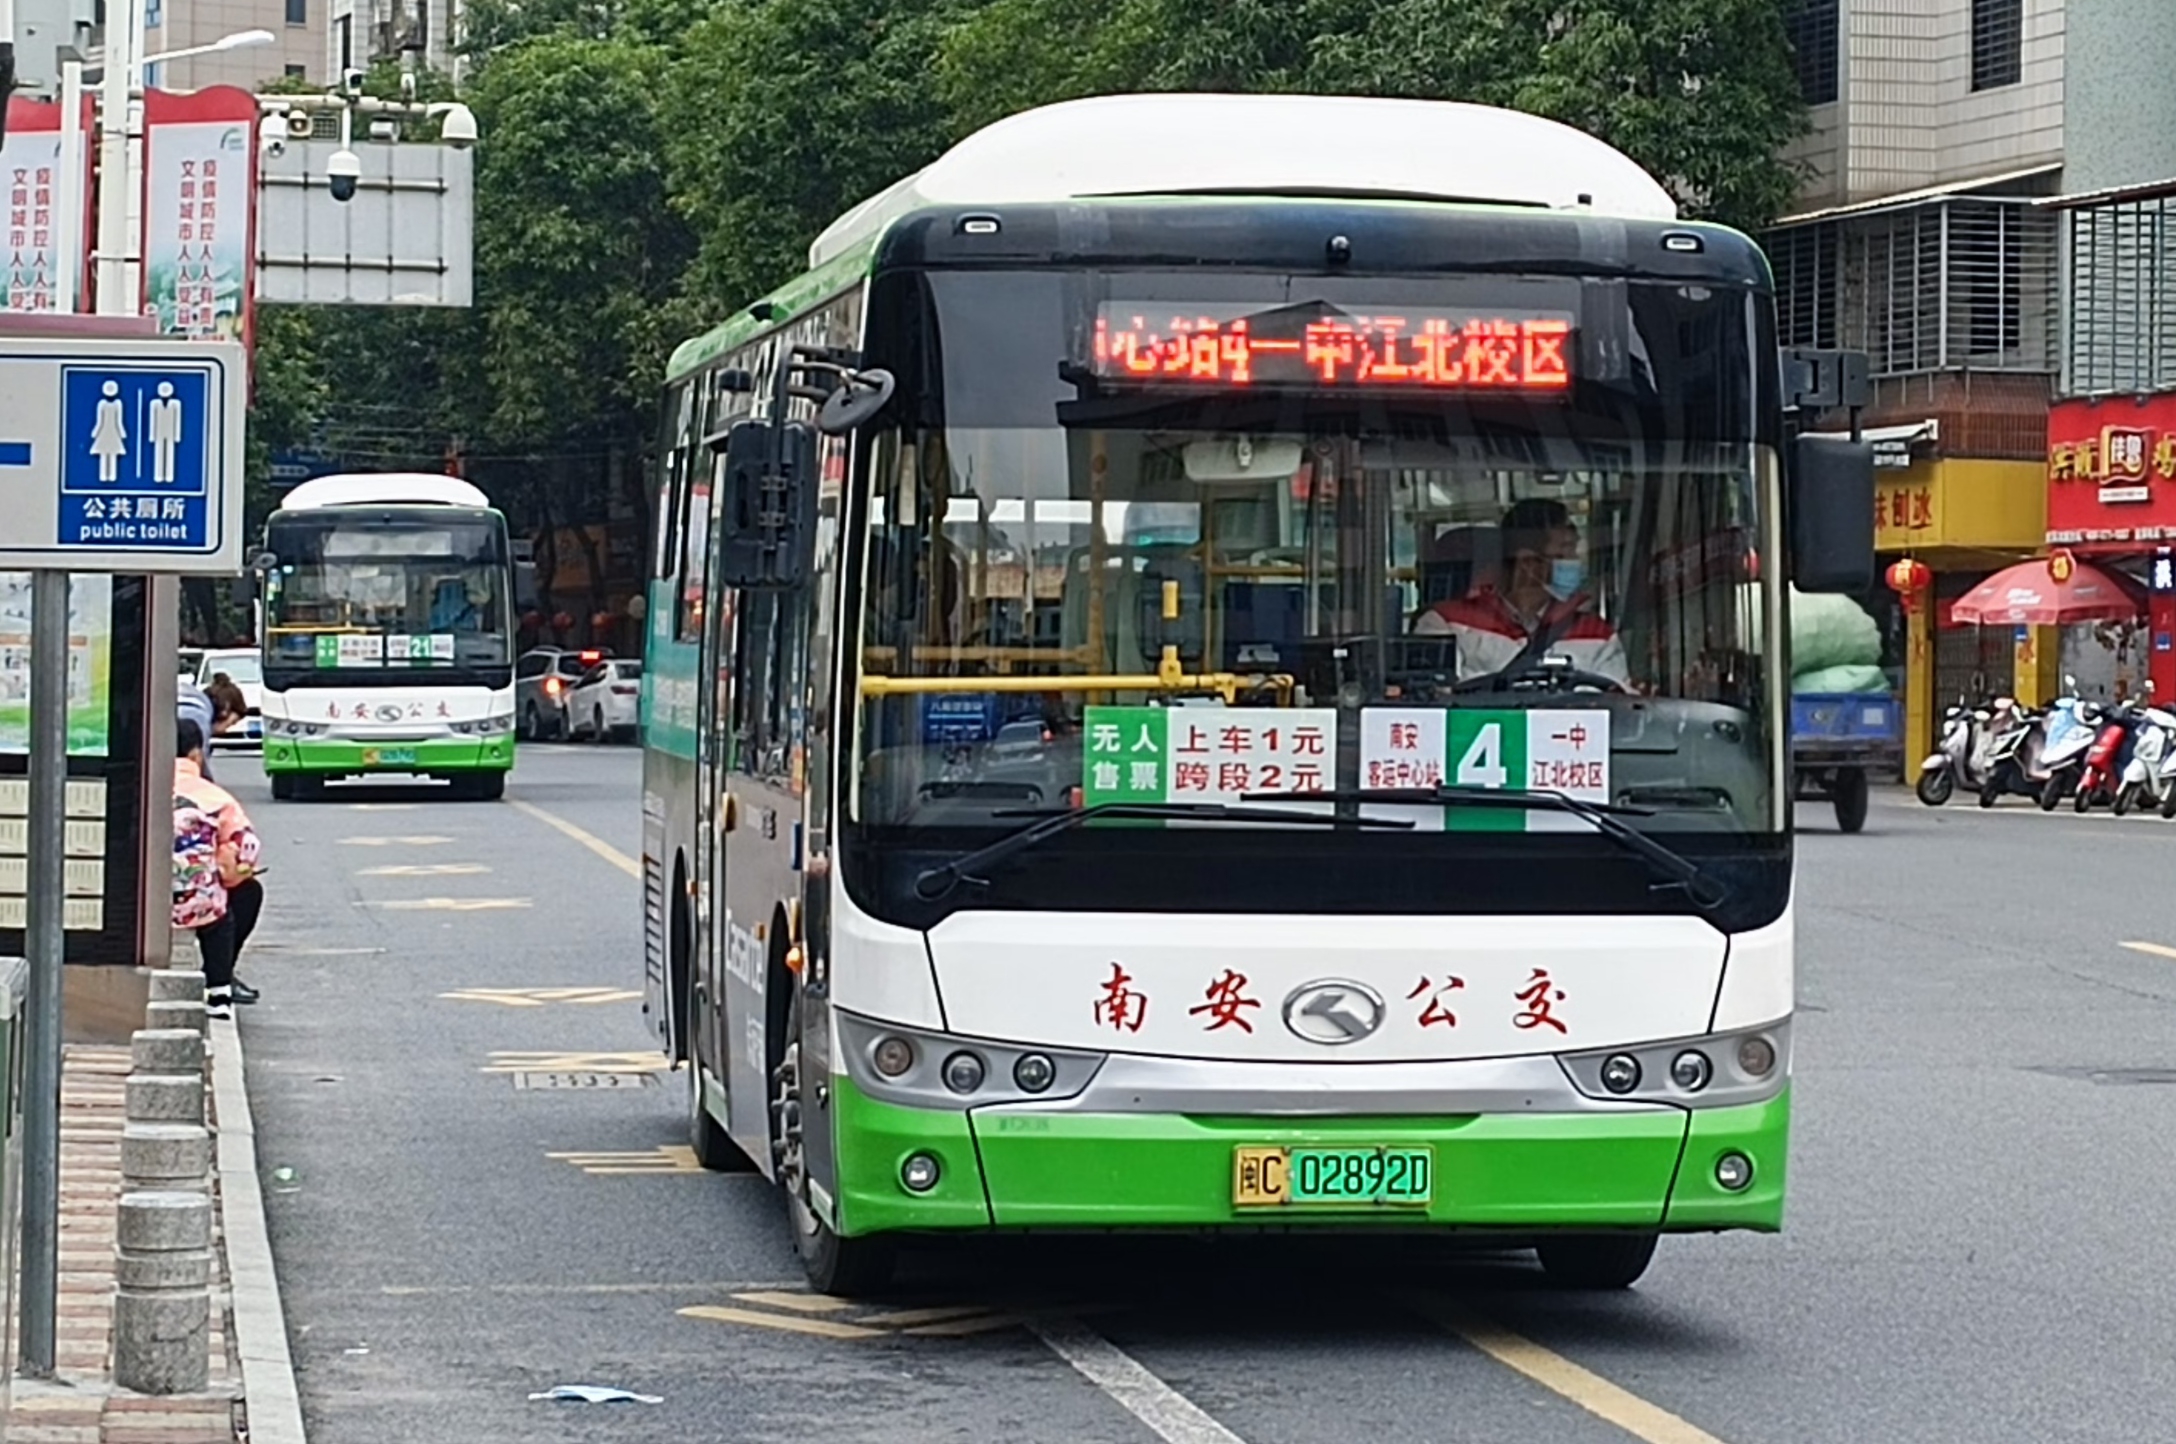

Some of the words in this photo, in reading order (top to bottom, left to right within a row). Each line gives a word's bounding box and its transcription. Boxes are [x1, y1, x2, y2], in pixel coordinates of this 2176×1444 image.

[82, 497, 186, 519] 公共厕所
[80, 522, 136, 541] public
[141, 524, 187, 539] toilet
[411, 638, 431, 657] 21
[1091, 724, 1158, 752] 无人
[1176, 725, 1325, 755] 上车1元
[1389, 722, 1418, 749] 南安
[1551, 722, 1586, 750] 一中
[1457, 723, 1507, 788] 4
[1091, 761, 1159, 791] 售票
[1175, 762, 1324, 793] 跨段2元
[1368, 759, 1441, 788] 客运中心站
[1533, 760, 1603, 788] 江北校区
